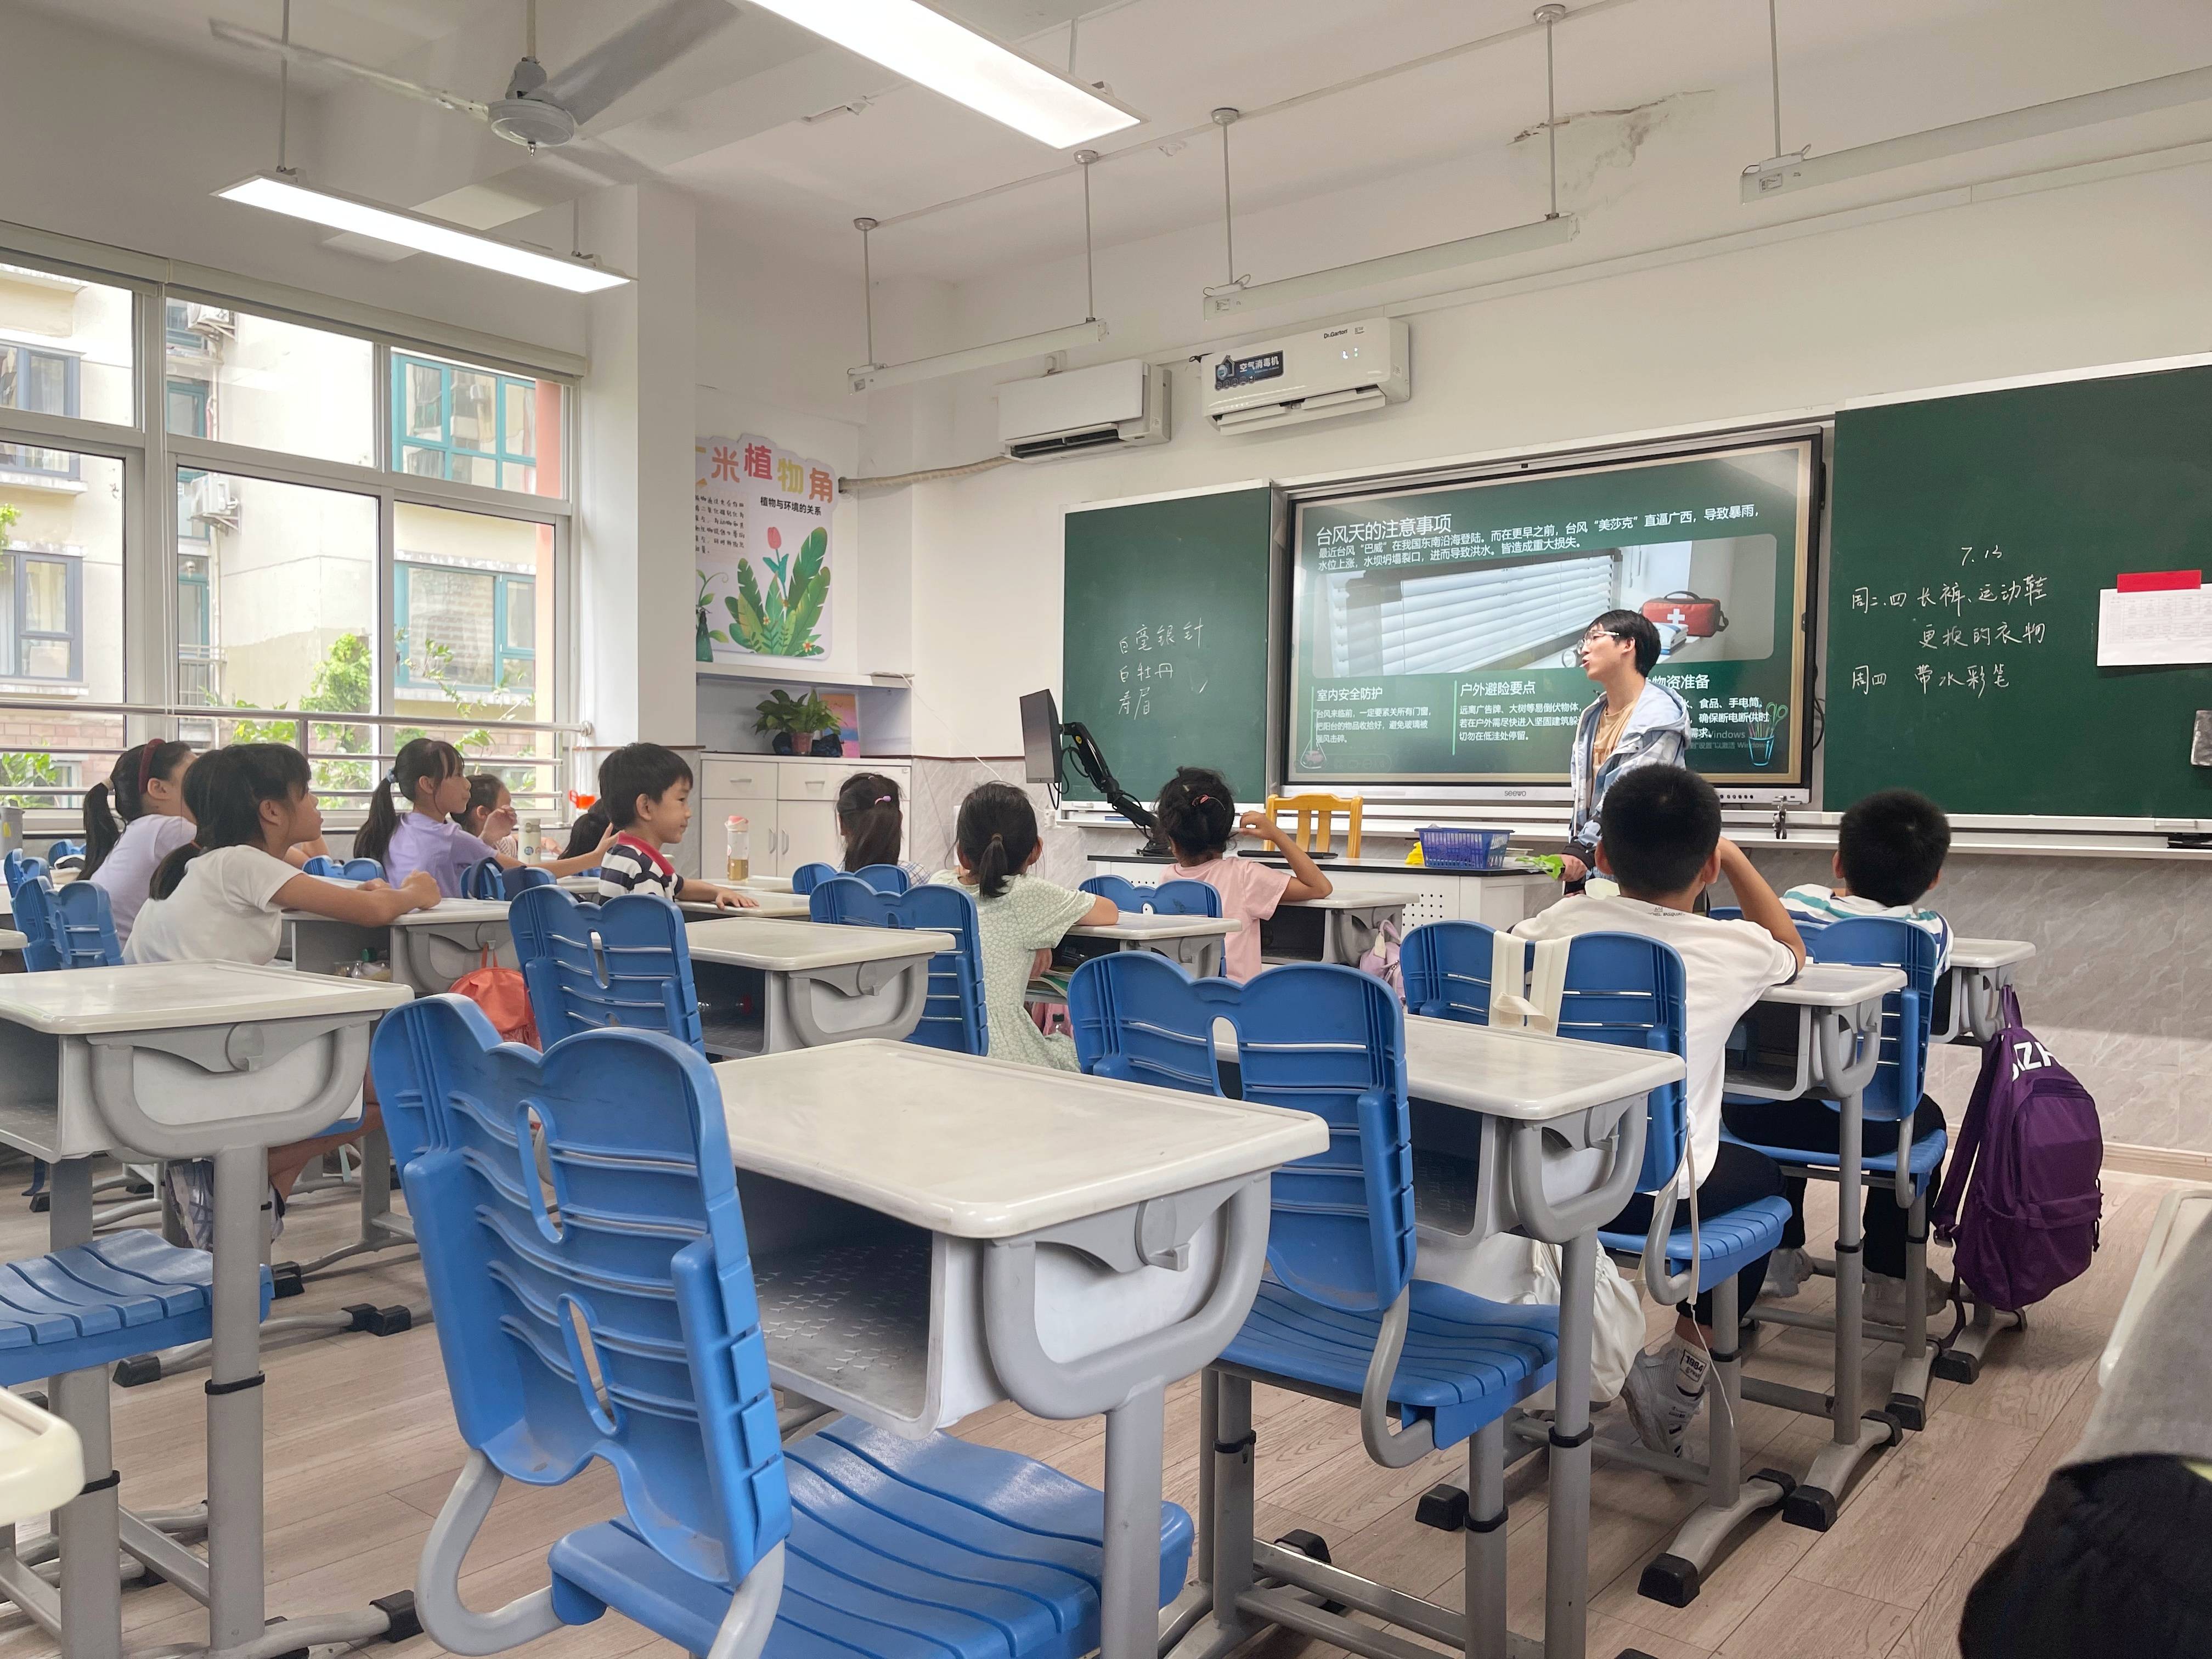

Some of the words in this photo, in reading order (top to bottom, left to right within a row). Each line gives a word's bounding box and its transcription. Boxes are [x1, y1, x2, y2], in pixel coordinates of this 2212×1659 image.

[1239, 356, 1279, 373] 空气消毒机
[696, 443, 833, 503] 米植物角
[760, 496, 821, 516] 植物与环境的关系
[1317, 514, 1452, 546] 台风天的注意事项
[1919, 622, 2045, 649] 更换的衣物
[1119, 663, 1173, 682] 白牡丹
[1646, 674, 1710, 690] 物资准备
[1852, 665, 1887, 695] 周四
[1914, 664, 2010, 698] 带水彩笔
[1317, 687, 1383, 702] 室内安全防护
[1460, 680, 1536, 697] 户外避险要点
[1459, 715, 1581, 729] 若在户外需尽快进入坚固建筑躲
